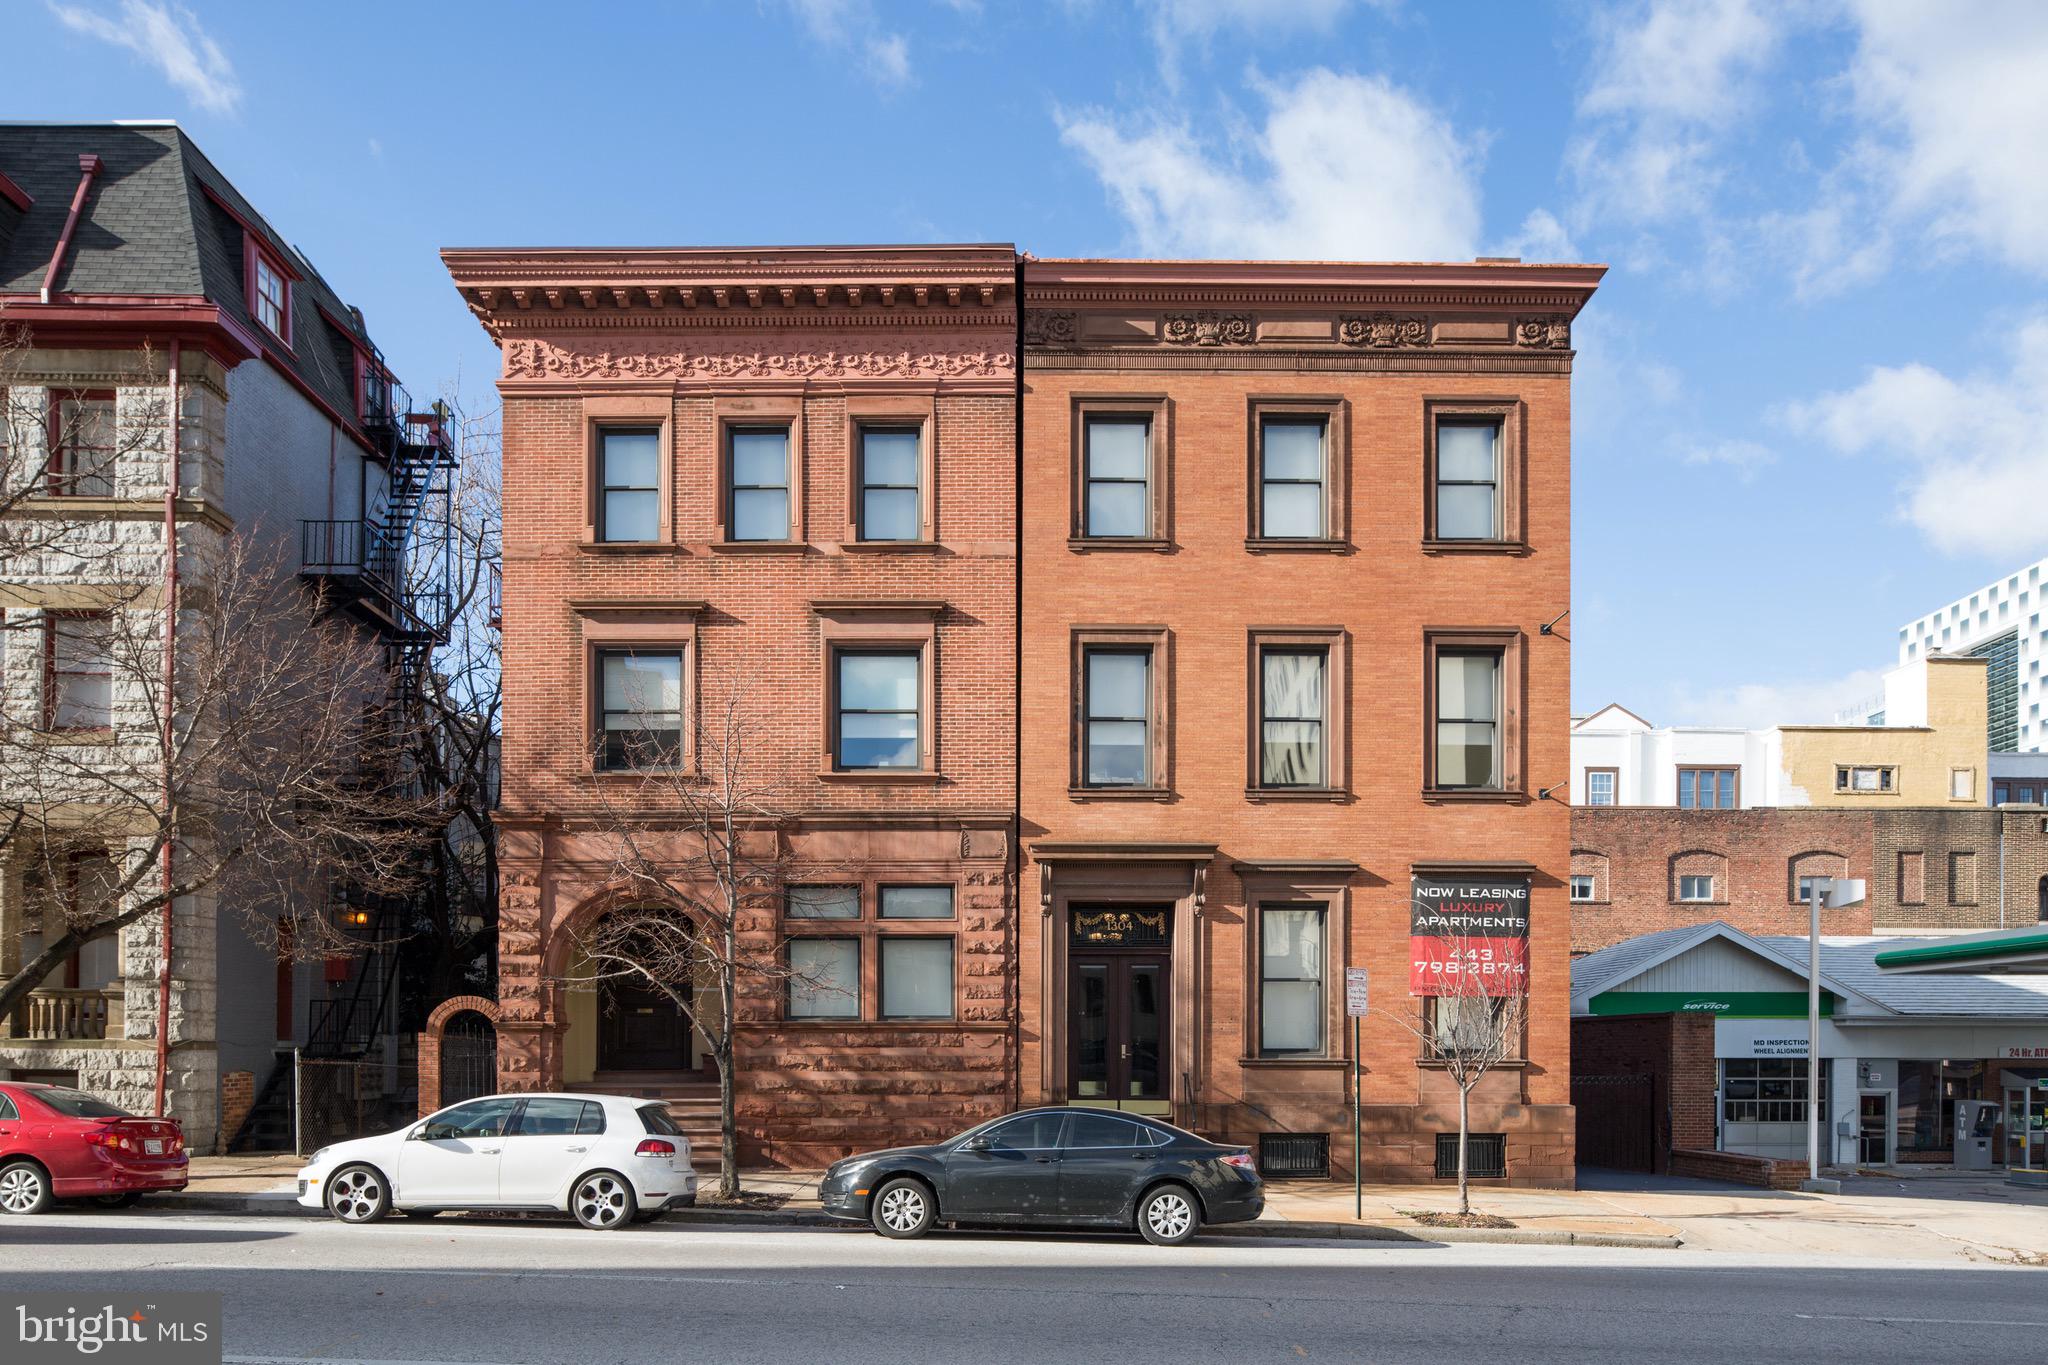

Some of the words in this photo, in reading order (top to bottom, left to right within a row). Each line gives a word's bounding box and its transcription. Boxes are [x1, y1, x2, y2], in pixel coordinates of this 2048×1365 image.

[1416, 887, 1455, 898] NOW
[1460, 888, 1527, 899] LEASING
[1439, 902, 1505, 913] LUXURY
[1106, 921, 1133, 931] 1304
[1415, 916, 1526, 928] APARTMENTS
[1449, 948, 1493, 960] 443
[1414, 961, 1525, 974] 798-2874
[1682, 1001, 1730, 1010] service
[2009, 1047, 2019, 1057] 24
[1958, 1104, 1967, 1141] ATM
